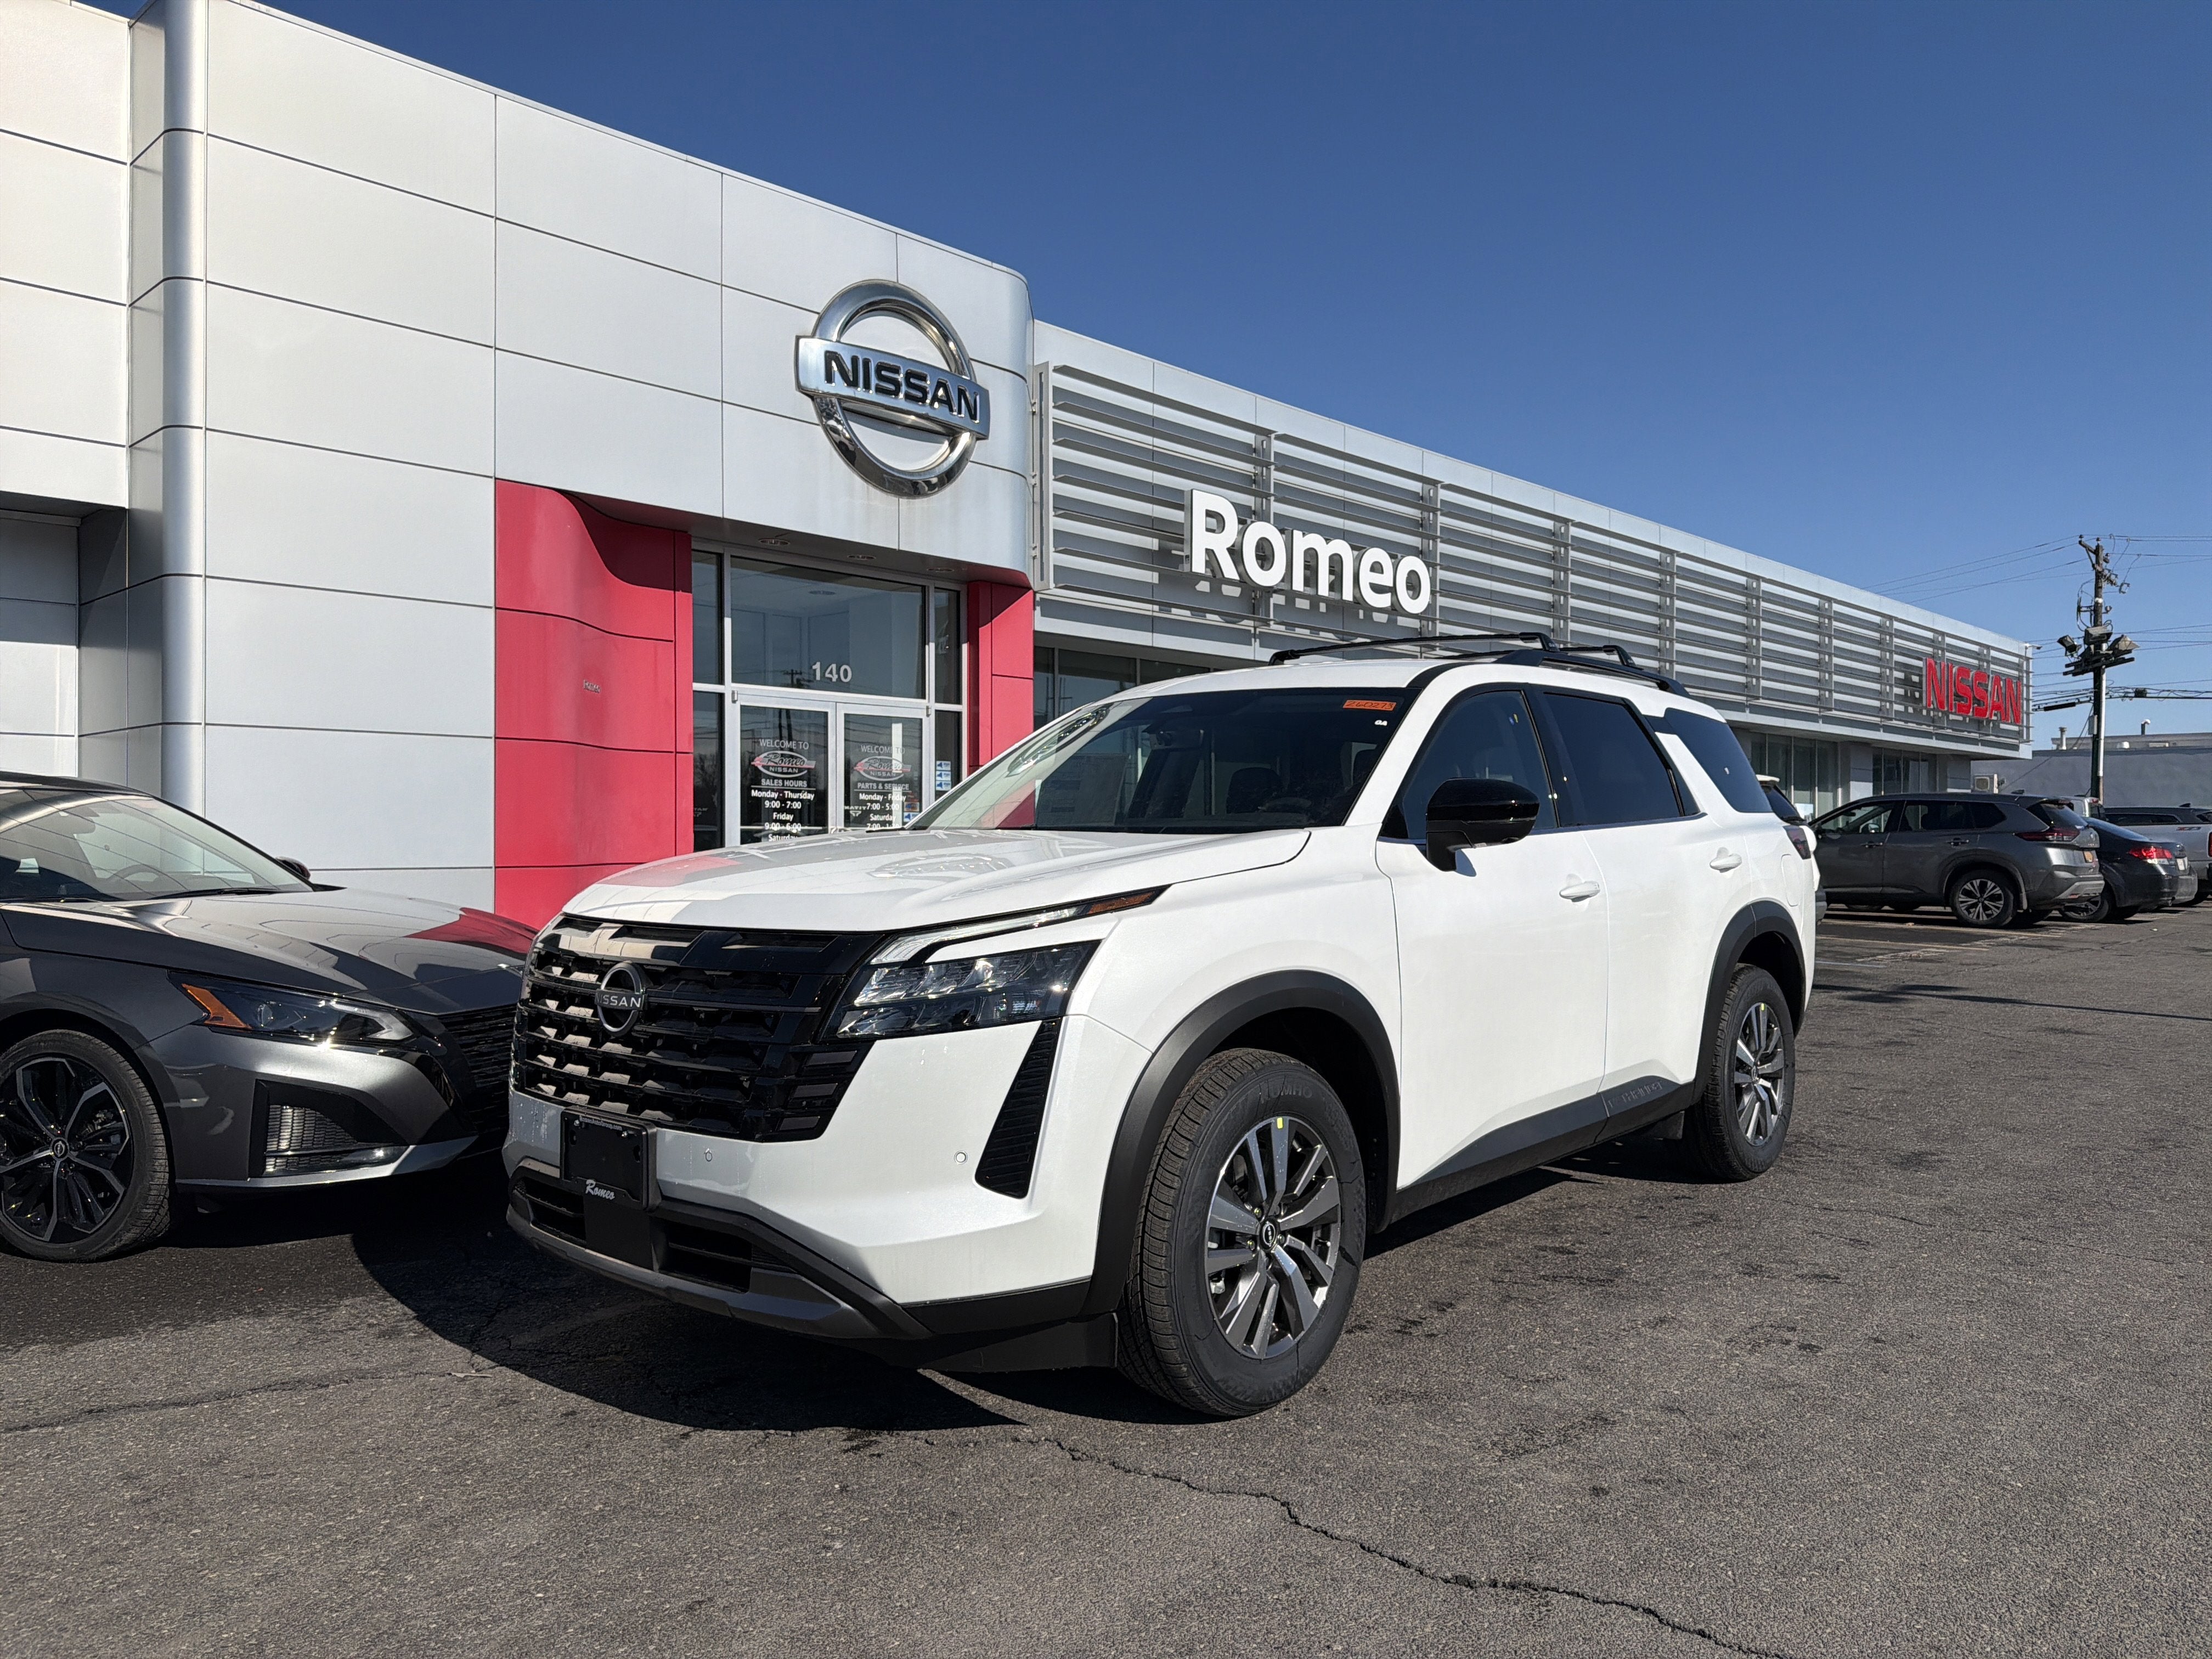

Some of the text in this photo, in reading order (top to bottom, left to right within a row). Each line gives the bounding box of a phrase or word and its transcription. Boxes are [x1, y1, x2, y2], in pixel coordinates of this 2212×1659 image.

[824, 350, 979, 424] NISSAN
[1189, 488, 1431, 614] Romeo
[812, 661, 852, 682] 140
[1925, 657, 2022, 725] NISSAN
[1345, 701, 1393, 709] 260273
[759, 738, 809, 750] WELCOME TO
[763, 752, 805, 766] Romeo
[865, 757, 902, 770] Romeo
[761, 778, 808, 788] SALES HOURS
[751, 789, 778, 800] Monday
[783, 791, 815, 801] Thursday
[859, 793, 884, 802] Monday
[888, 793, 907, 803] Friday
[764, 800, 781, 808] 9:00
[786, 801, 802, 809] 7:00
[773, 812, 794, 821] Friday
[870, 813, 896, 822] Saturday
[764, 822, 781, 831] 9:00
[585, 1179, 616, 1200] Romeo
